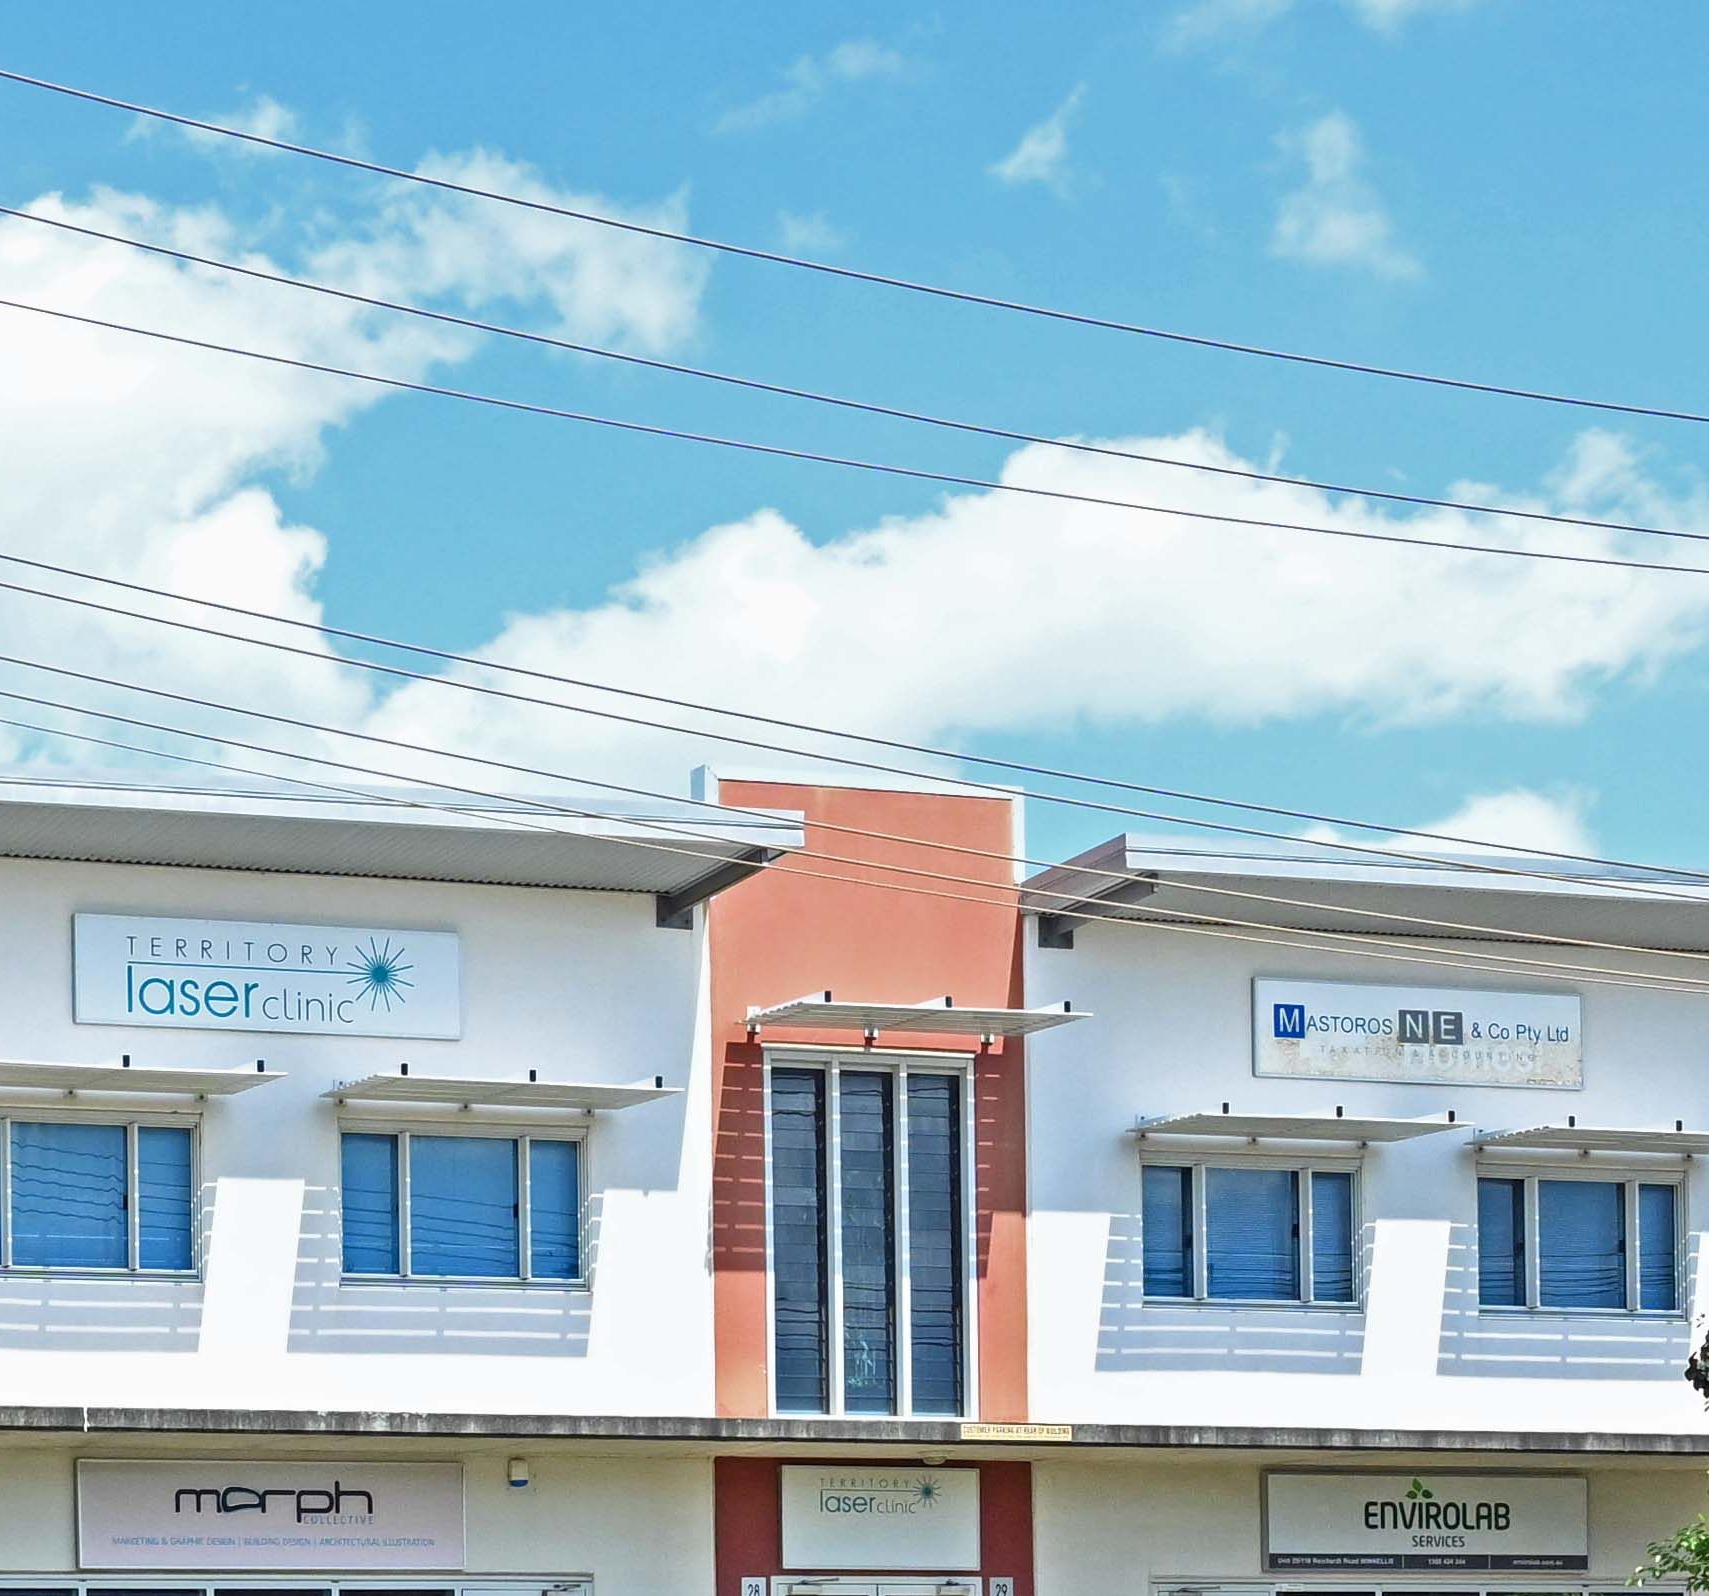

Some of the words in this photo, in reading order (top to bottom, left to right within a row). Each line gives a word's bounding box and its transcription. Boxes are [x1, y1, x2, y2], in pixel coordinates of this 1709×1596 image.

[126, 936, 339, 966] TERRITORY
[1279, 1006, 1393, 1036] MASTOROS
[1471, 1022, 1482, 1039] &
[1488, 1023, 1510, 1040] Co
[1516, 1024, 1541, 1045] Pty
[1547, 1025, 1569, 1042] Ltd
[820, 1478, 910, 1488] TERRITORY
[175, 1481, 373, 1523] morph
[1364, 1501, 1510, 1531] ENVIROLAB
[303, 1515, 374, 1525] COLLECTIVE
[1412, 1535, 1466, 1548] SERVICES
